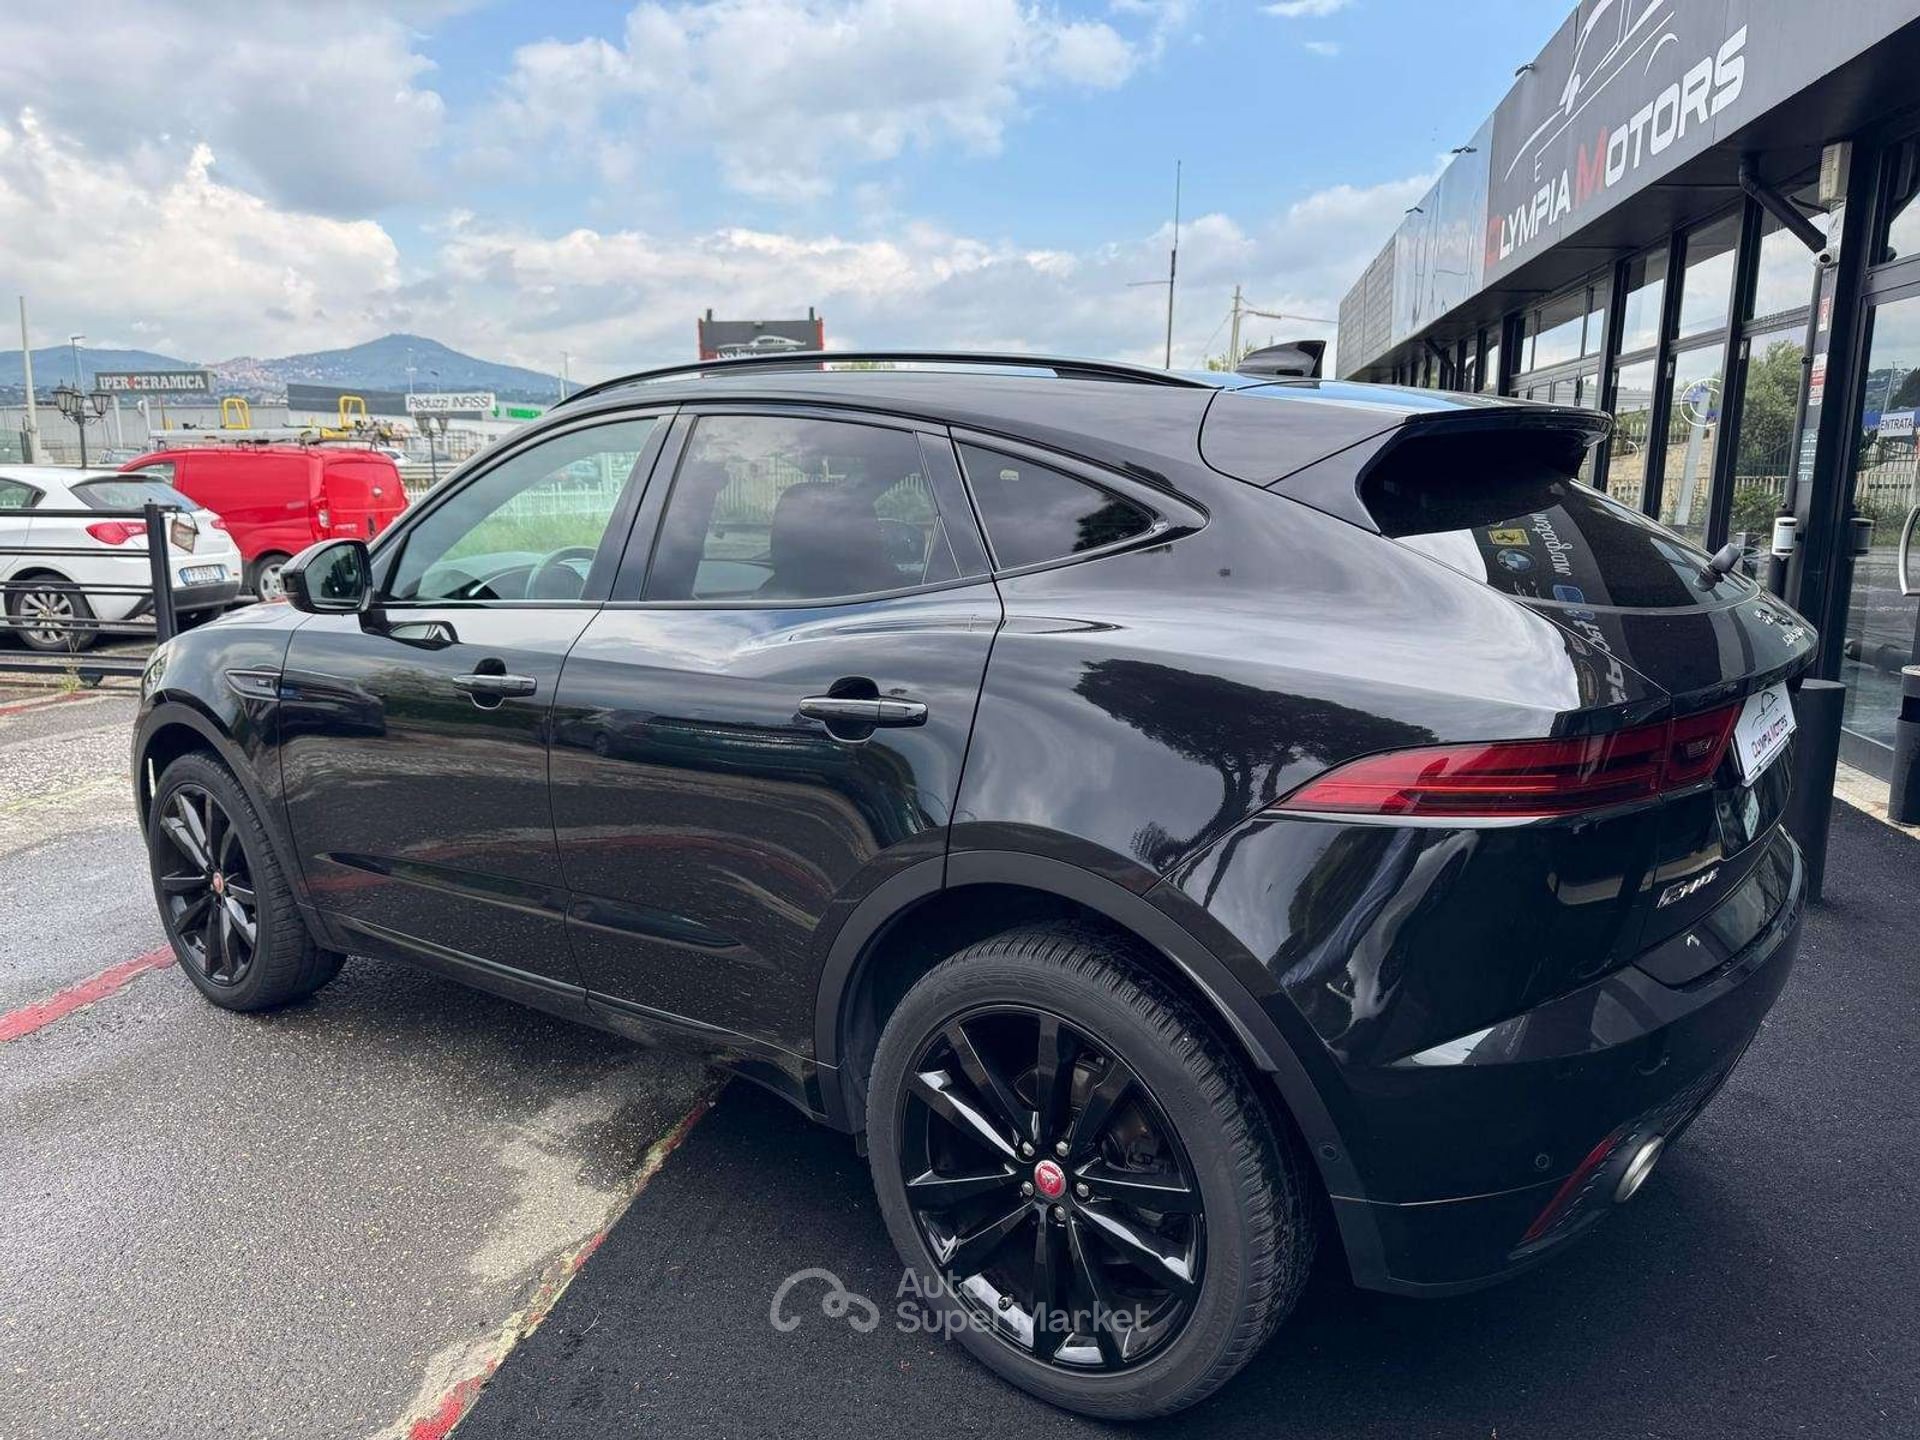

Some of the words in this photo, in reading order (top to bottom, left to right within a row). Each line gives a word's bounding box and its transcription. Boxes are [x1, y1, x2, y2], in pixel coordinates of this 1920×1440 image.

[1484, 169, 1571, 268] OLYMPIA
[1575, 24, 1747, 209] MOTORS
[1881, 417, 1913, 431] ENTRATA
